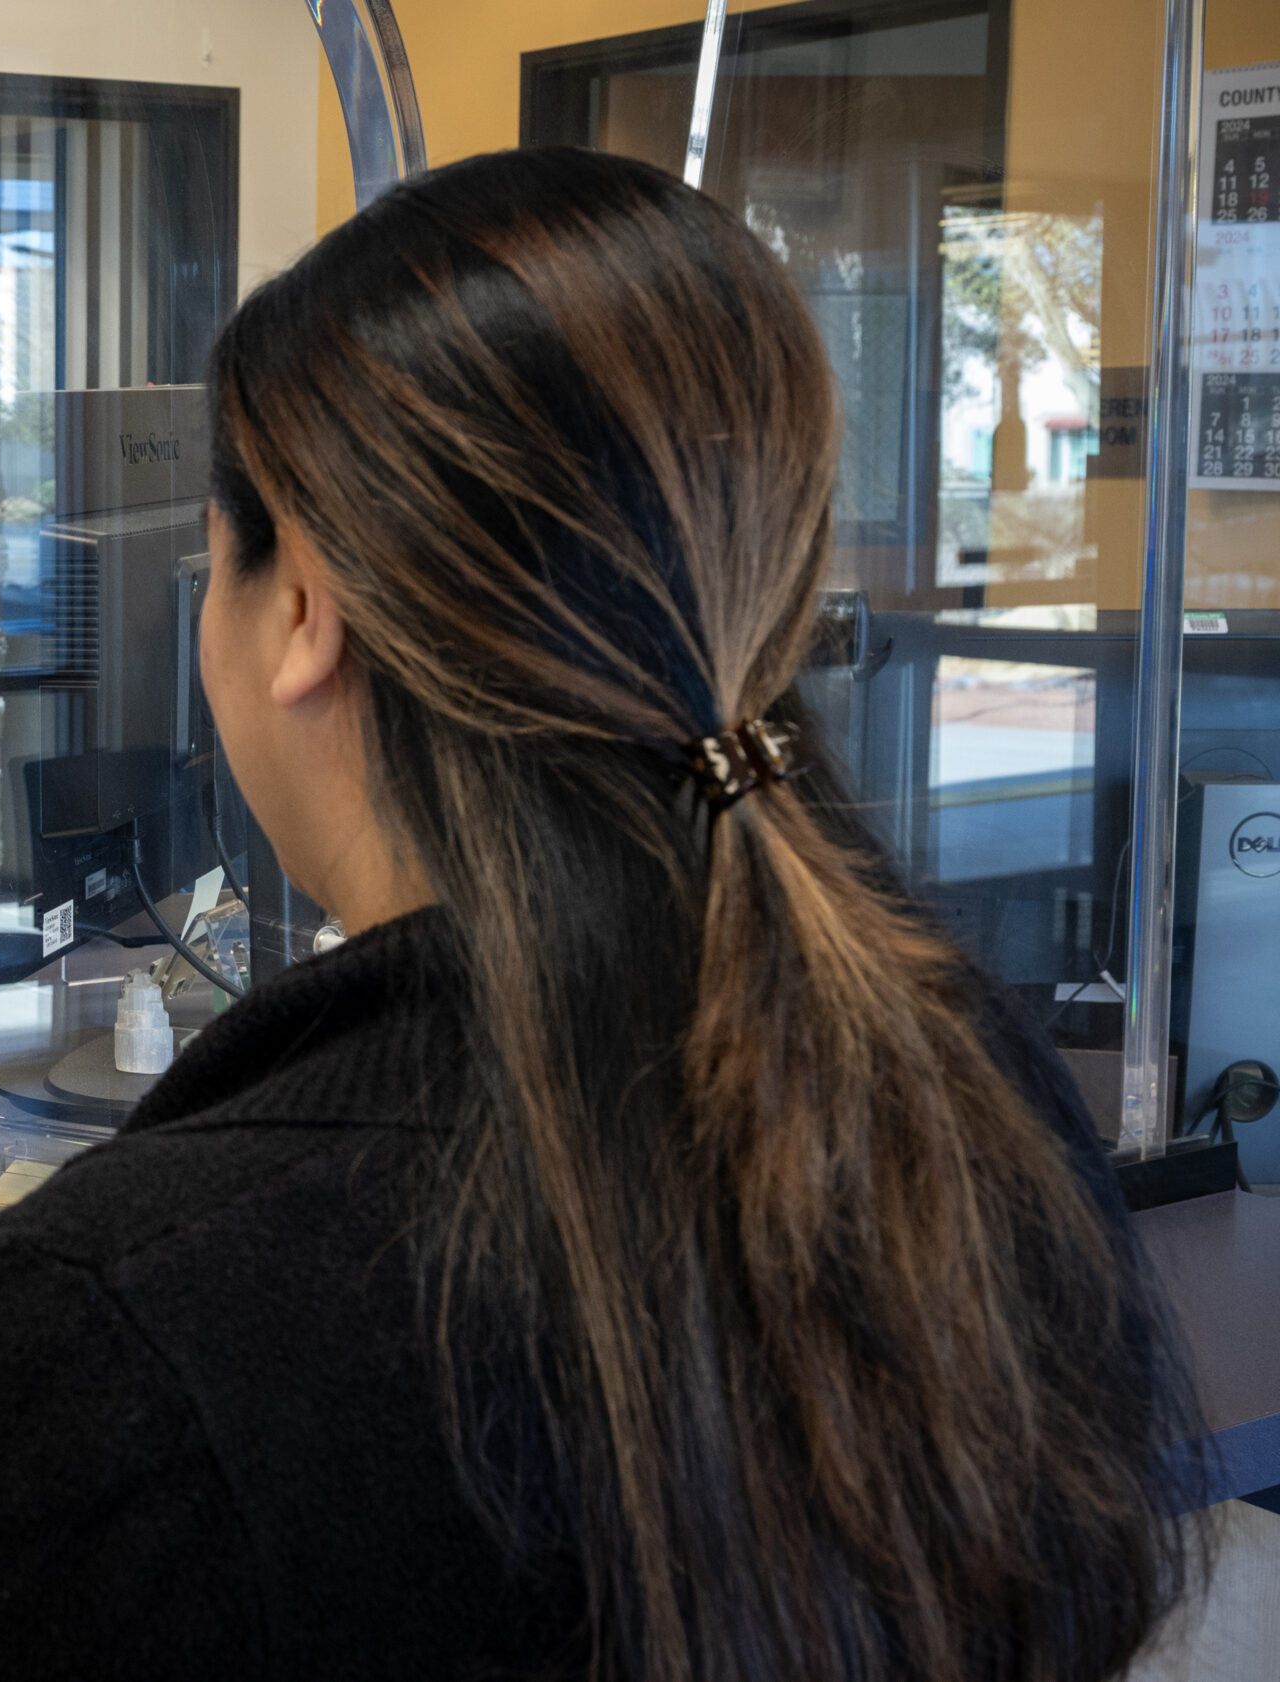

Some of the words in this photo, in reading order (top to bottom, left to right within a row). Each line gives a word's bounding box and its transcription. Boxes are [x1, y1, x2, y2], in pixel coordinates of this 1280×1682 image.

[1224, 158, 1235, 173] 4
[1254, 156, 1266, 172] 5
[1218, 176, 1238, 190] 11
[1249, 173, 1270, 189] 12
[1218, 192, 1238, 208] 18
[1250, 190, 1269, 206] 19
[1216, 208, 1238, 223] 25
[1247, 206, 1268, 222] 26
[1215, 231, 1250, 245] 2024
[1217, 284, 1229, 299] 3
[1247, 283, 1258, 297] 4
[1212, 305, 1233, 321] 10
[1242, 305, 1260, 320] 11
[1212, 328, 1231, 344] 17
[1241, 327, 1262, 343] 18
[1239, 349, 1261, 365] 25
[1206, 374, 1237, 387] 2024
[1241, 396, 1251, 411] 1
[1210, 412, 1221, 427] 7
[1240, 412, 1251, 428] 8
[1205, 428, 1225, 443] 14
[119, 431, 181, 464] ViewSonic
[1203, 444, 1223, 460] 21
[1233, 445, 1255, 461] 22
[1202, 460, 1223, 476] 28
[1232, 461, 1254, 477] 29
[1237, 836, 1280, 853] DEL
